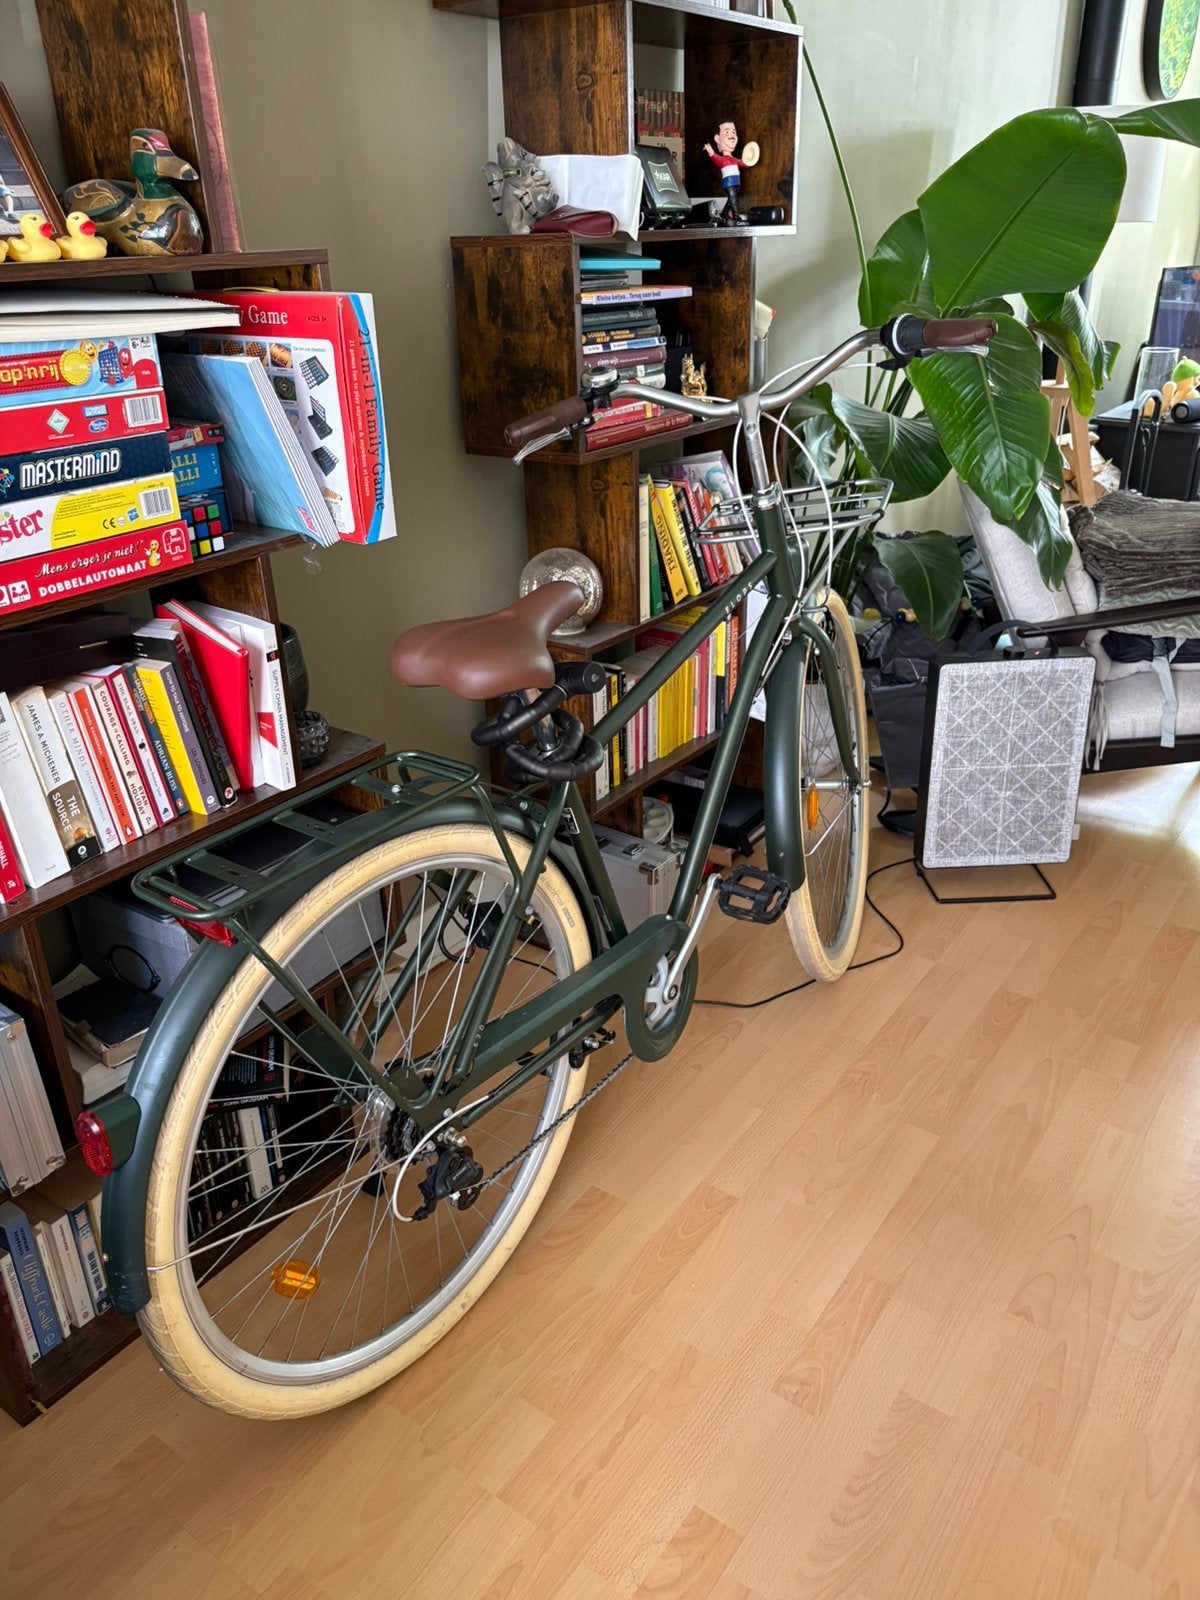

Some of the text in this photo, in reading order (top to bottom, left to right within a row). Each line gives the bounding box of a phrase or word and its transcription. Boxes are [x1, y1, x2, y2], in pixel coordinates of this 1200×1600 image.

[248, 305, 288, 325] Game
[358, 328, 385, 510] 21-in-1 Family Game
[21, 450, 121, 488] MASTERMIND
[170, 452, 198, 468] ALLI
[175, 467, 200, 482] ALLI
[35, 560, 69, 578] Mens
[71, 553, 100, 569] erger
[99, 548, 114, 564] je
[656, 515, 678, 574] TRADING
[38, 560, 147, 597] DOBBELAUTOMAAT
[724, 582, 753, 614] ELOPS
[270, 669, 279, 691] SUPPLY
[164, 671, 190, 732] HOW TO TALK TO ANYONE
[274, 692, 282, 712] CHAIN
[27, 704, 42, 732] JAMES
[41, 740, 61, 784] MICHENER
[58, 701, 87, 766] OTHER MINDS
[98, 690, 117, 727] COURAGE
[114, 733, 131, 765] CALLING
[277, 714, 289, 755] MANAGEMENT
[152, 739, 179, 791] ADRIAN BLISS
[51, 792, 73, 833] SOURCE
[66, 795, 81, 817] THE
[129, 782, 146, 815] HOLIDAY
[136, 785, 148, 806] RYAN
[21, 1253, 46, 1301] Cliffrock
[37, 1300, 54, 1332] Castle
